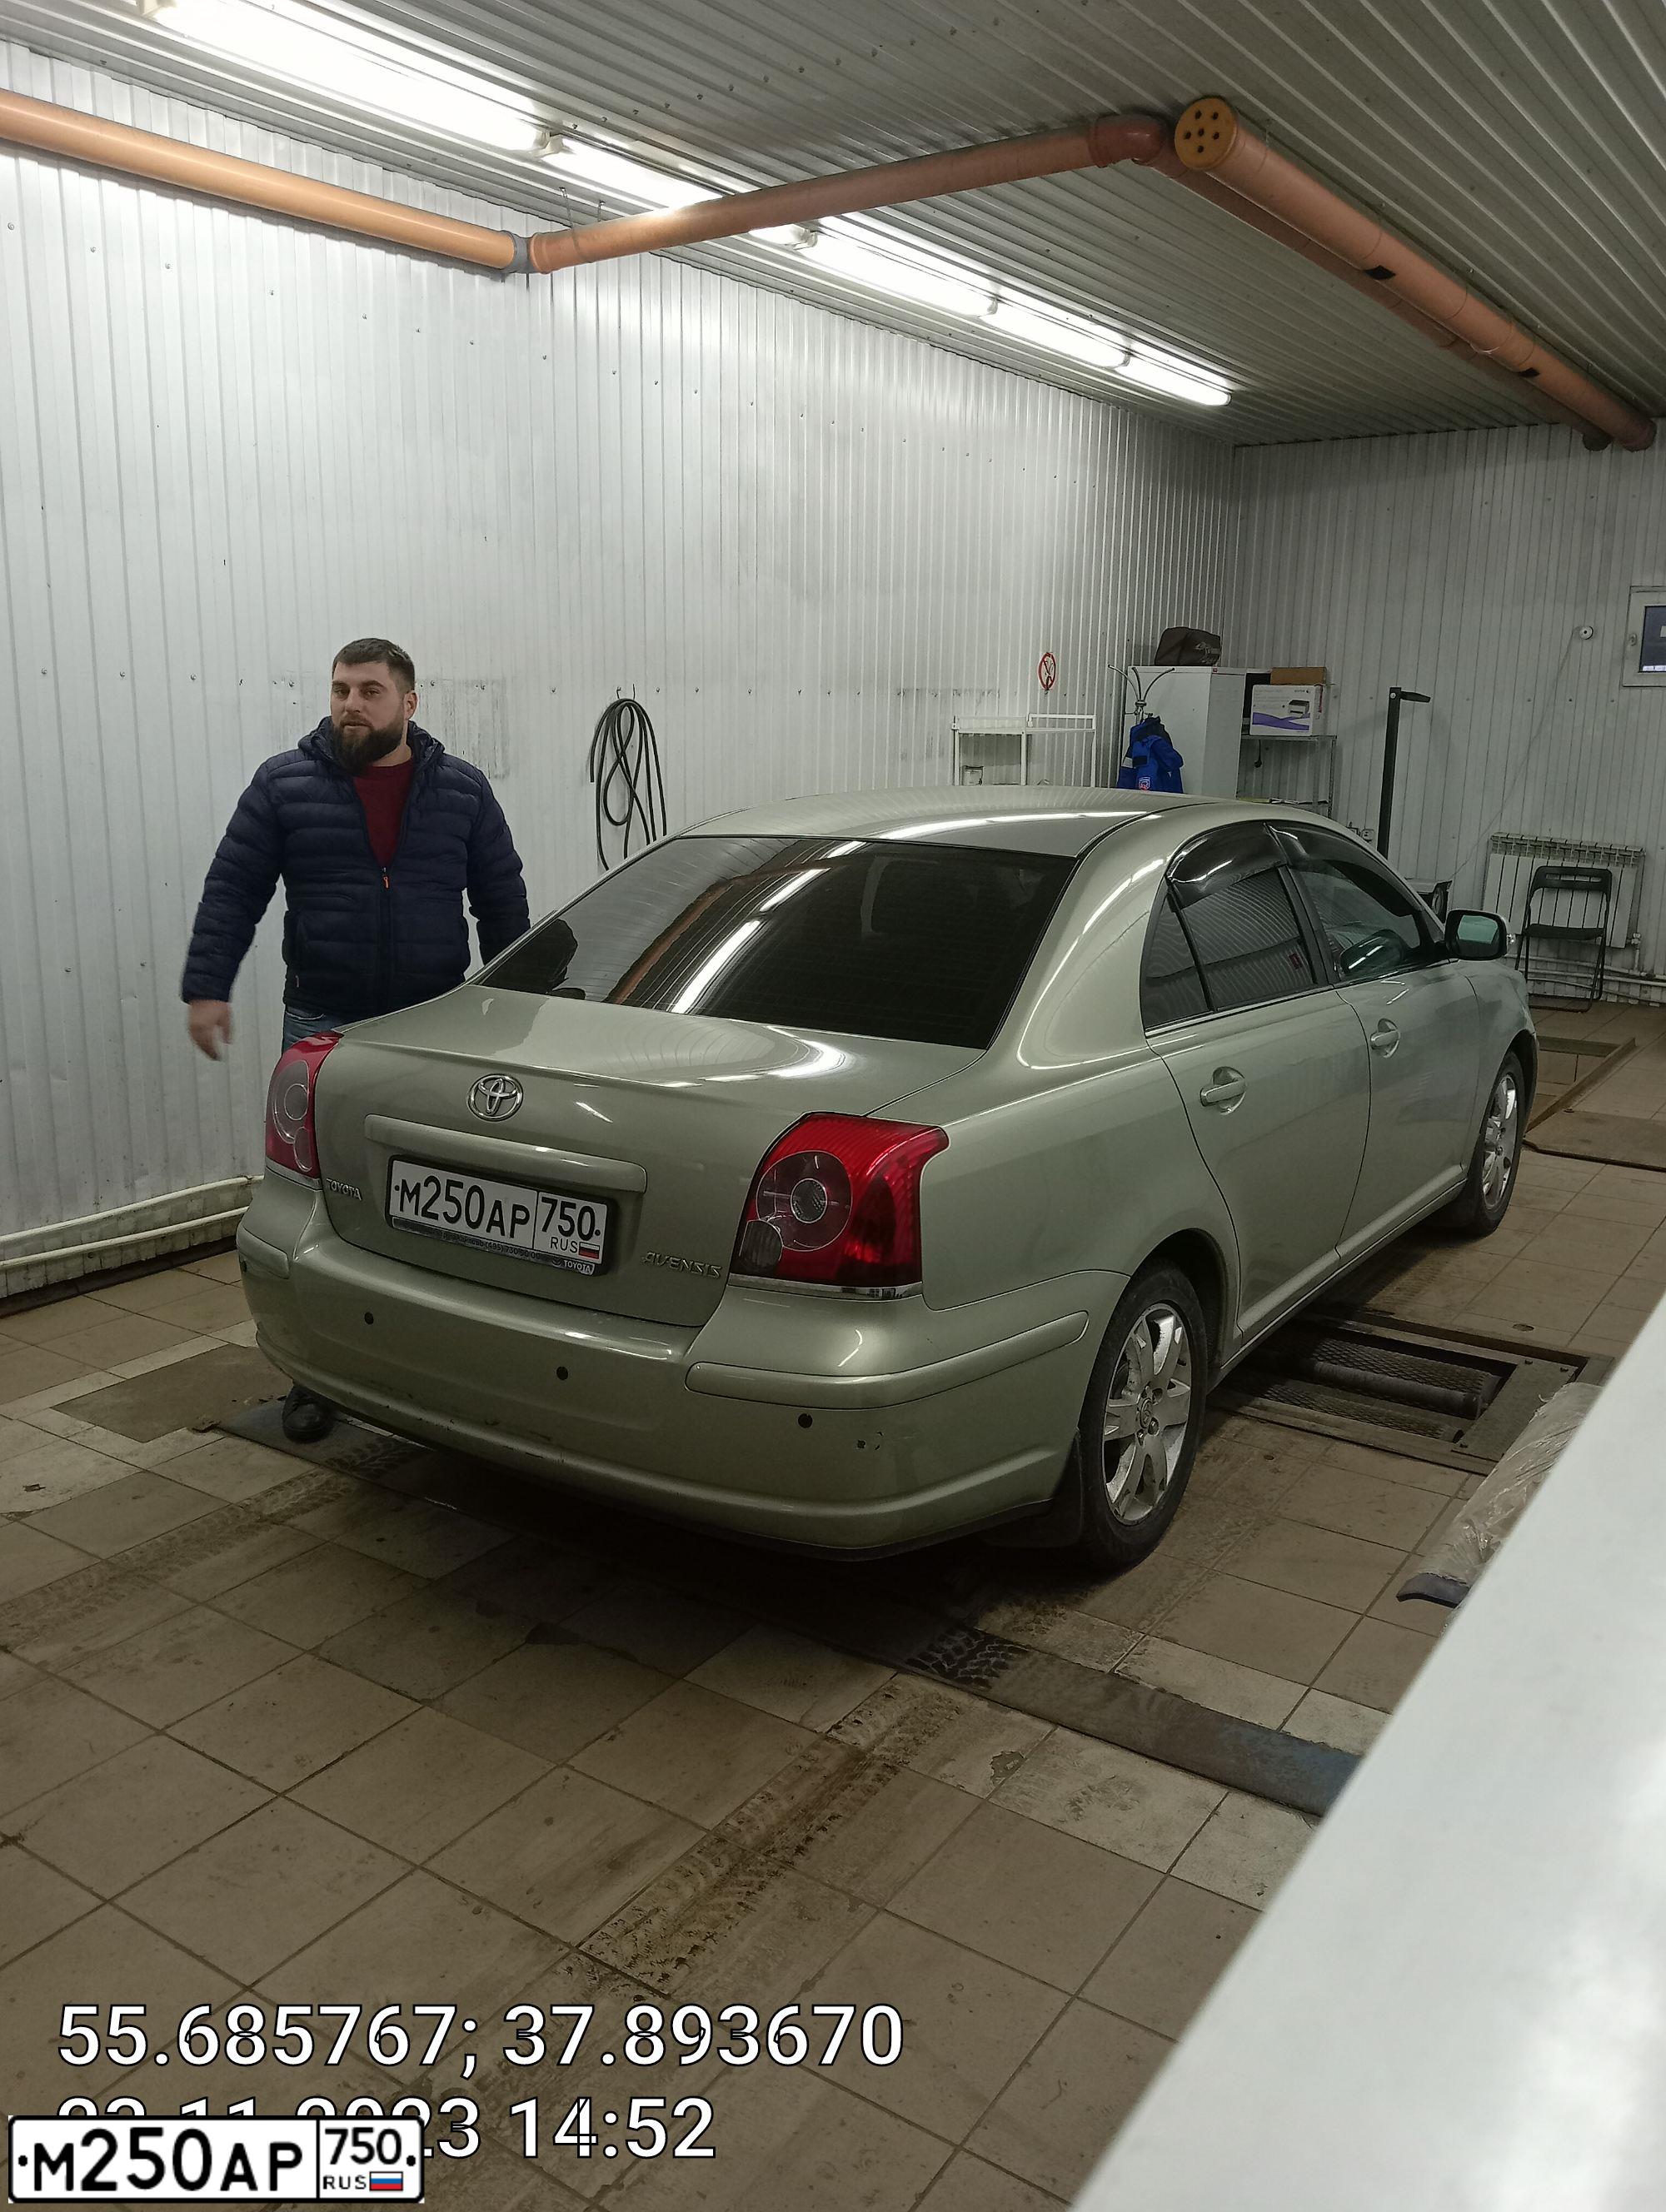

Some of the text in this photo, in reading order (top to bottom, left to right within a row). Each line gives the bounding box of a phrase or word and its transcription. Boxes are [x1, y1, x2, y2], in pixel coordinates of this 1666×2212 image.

[326, 1178, 362, 1201] TOYOTA
[541, 1197, 596, 1241] 750
[551, 1236, 578, 1253] RUS
[564, 1259, 591, 1273] TOYOTA
[641, 1252, 722, 1278] AVENSIS
